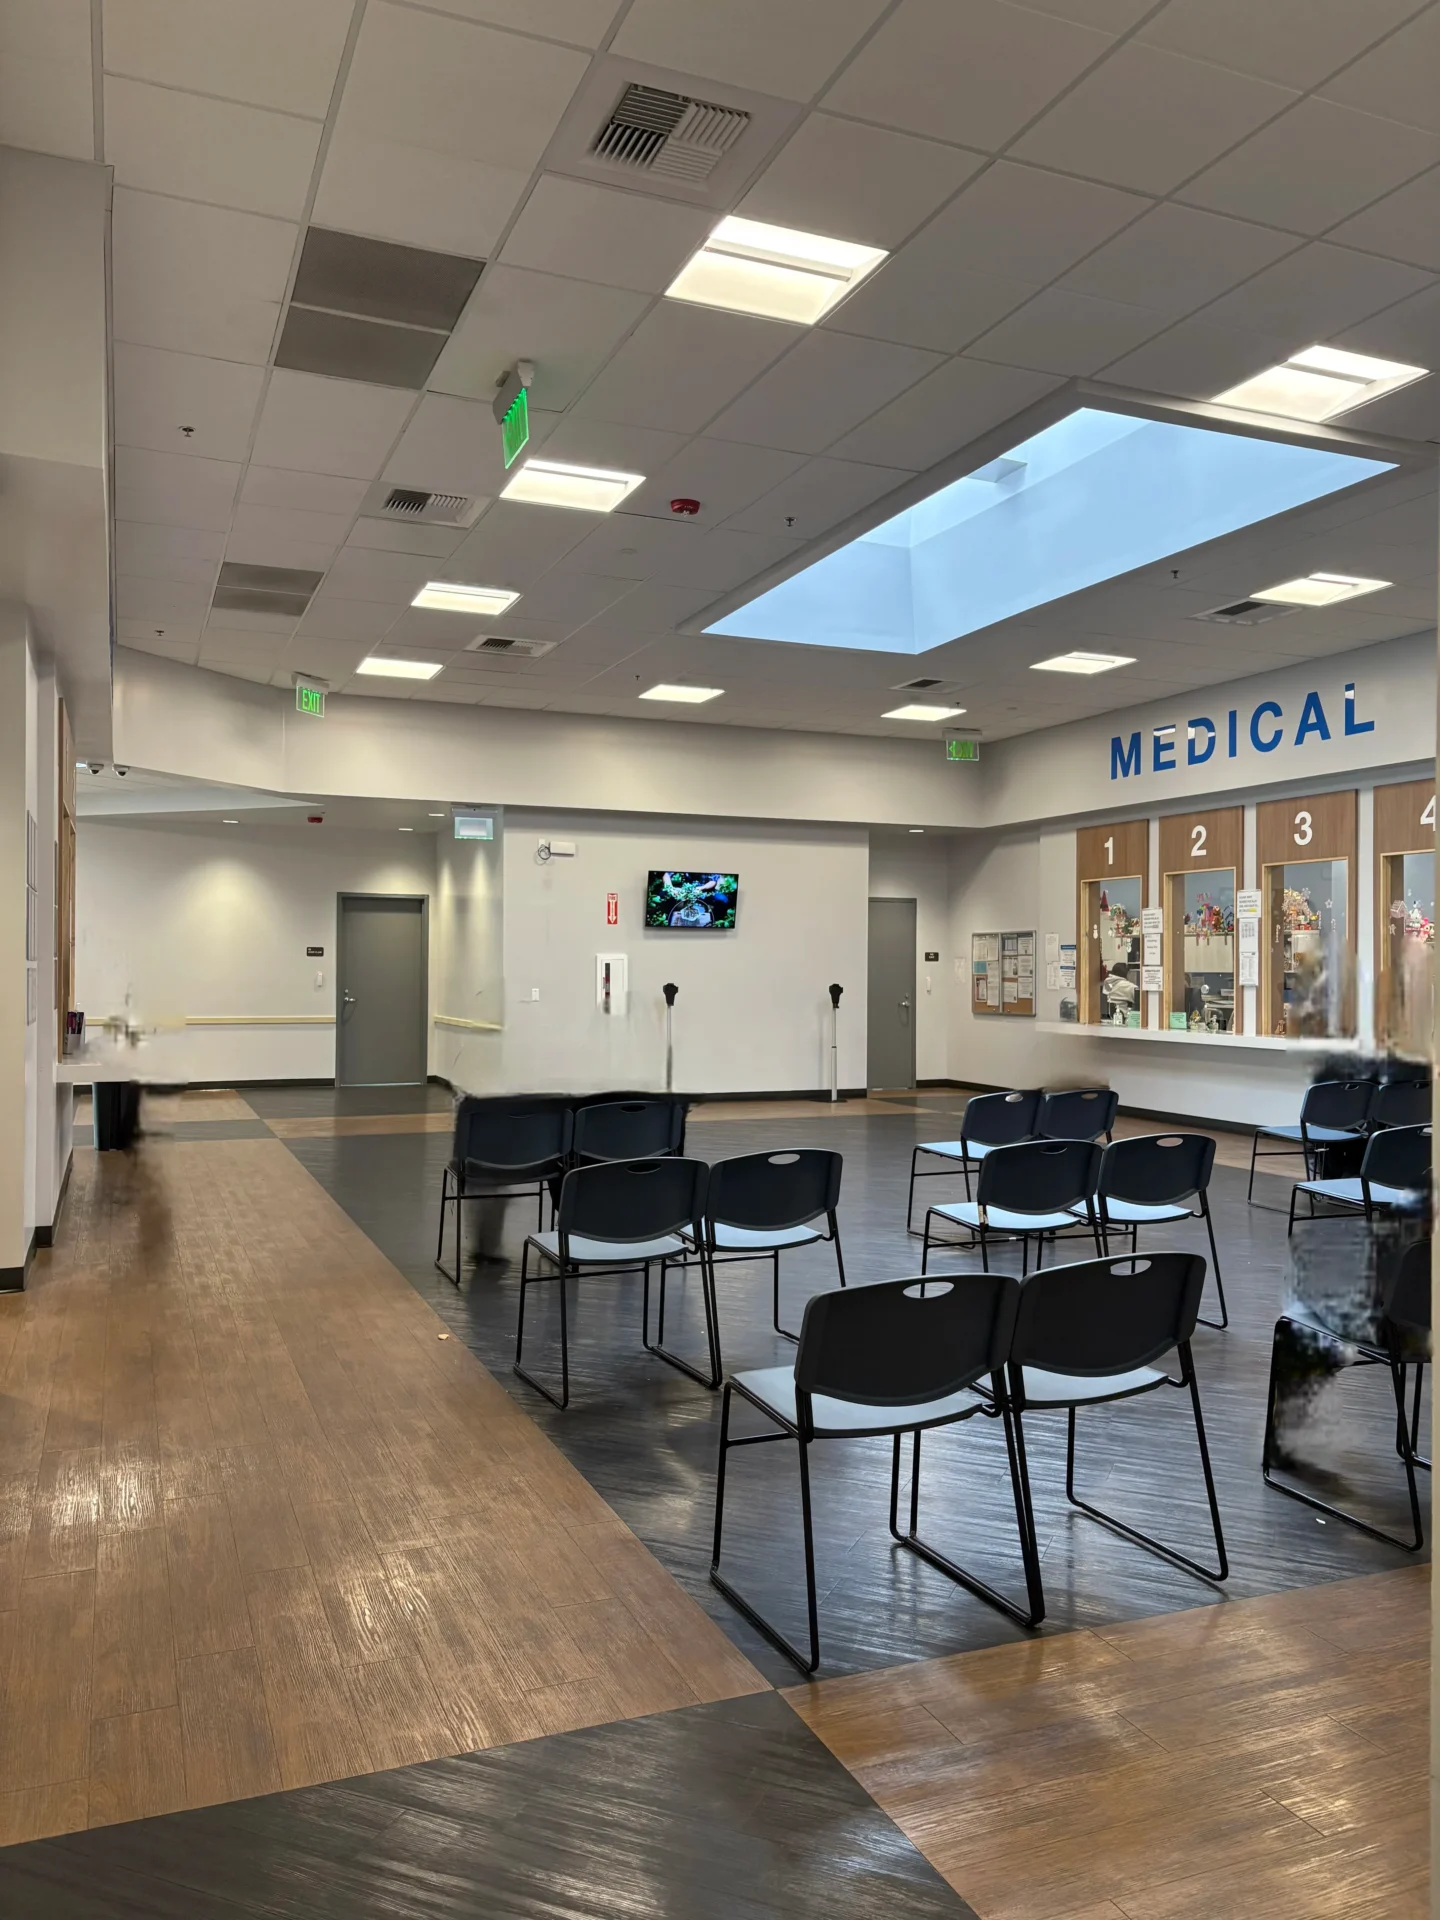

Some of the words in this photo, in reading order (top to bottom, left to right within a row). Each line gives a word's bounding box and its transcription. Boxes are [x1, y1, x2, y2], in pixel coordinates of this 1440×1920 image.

[302, 689, 321, 713] EXIT
[1111, 683, 1375, 780] MEDICAL
[1293, 811, 1313, 846] 3
[1420, 794, 1436, 832] 4
[1104, 836, 1113, 865] 1
[1190, 825, 1207, 857] 2
